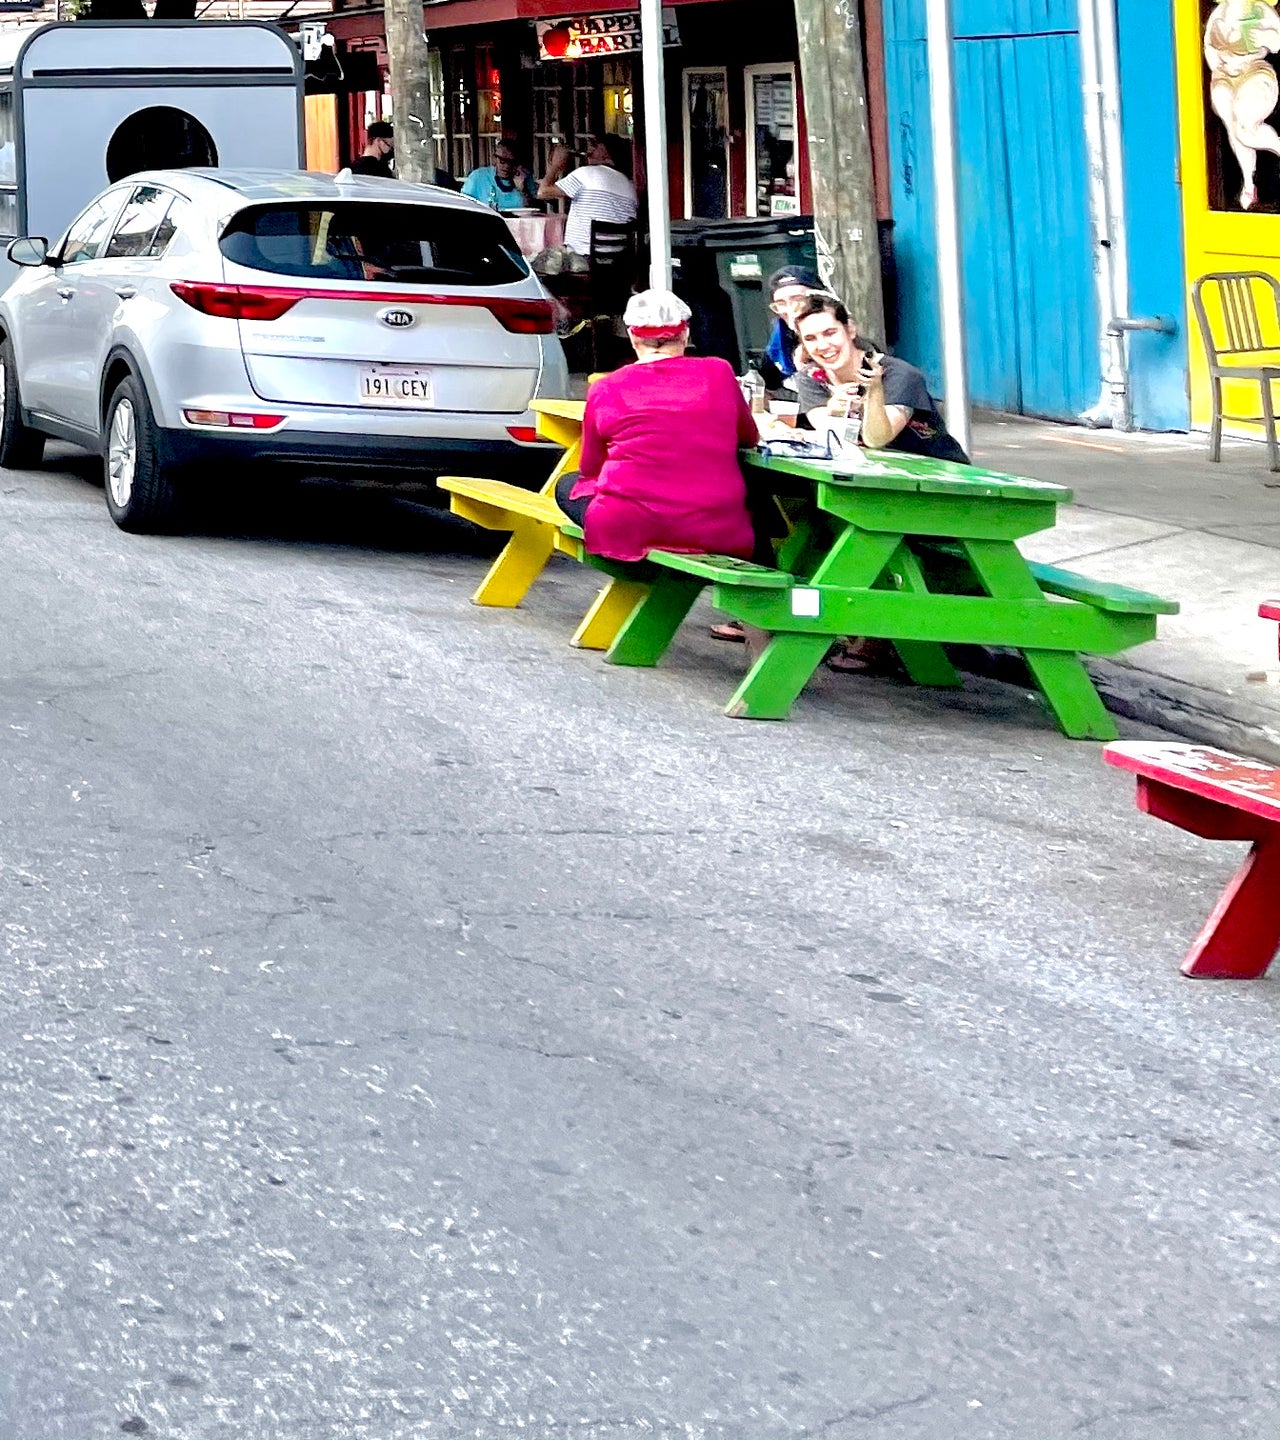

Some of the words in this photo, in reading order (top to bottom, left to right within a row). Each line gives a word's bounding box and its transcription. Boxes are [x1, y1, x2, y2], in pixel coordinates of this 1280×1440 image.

[387, 312, 410, 326] KIA
[365, 377, 389, 396] 191
[401, 380, 428, 397] CEY
